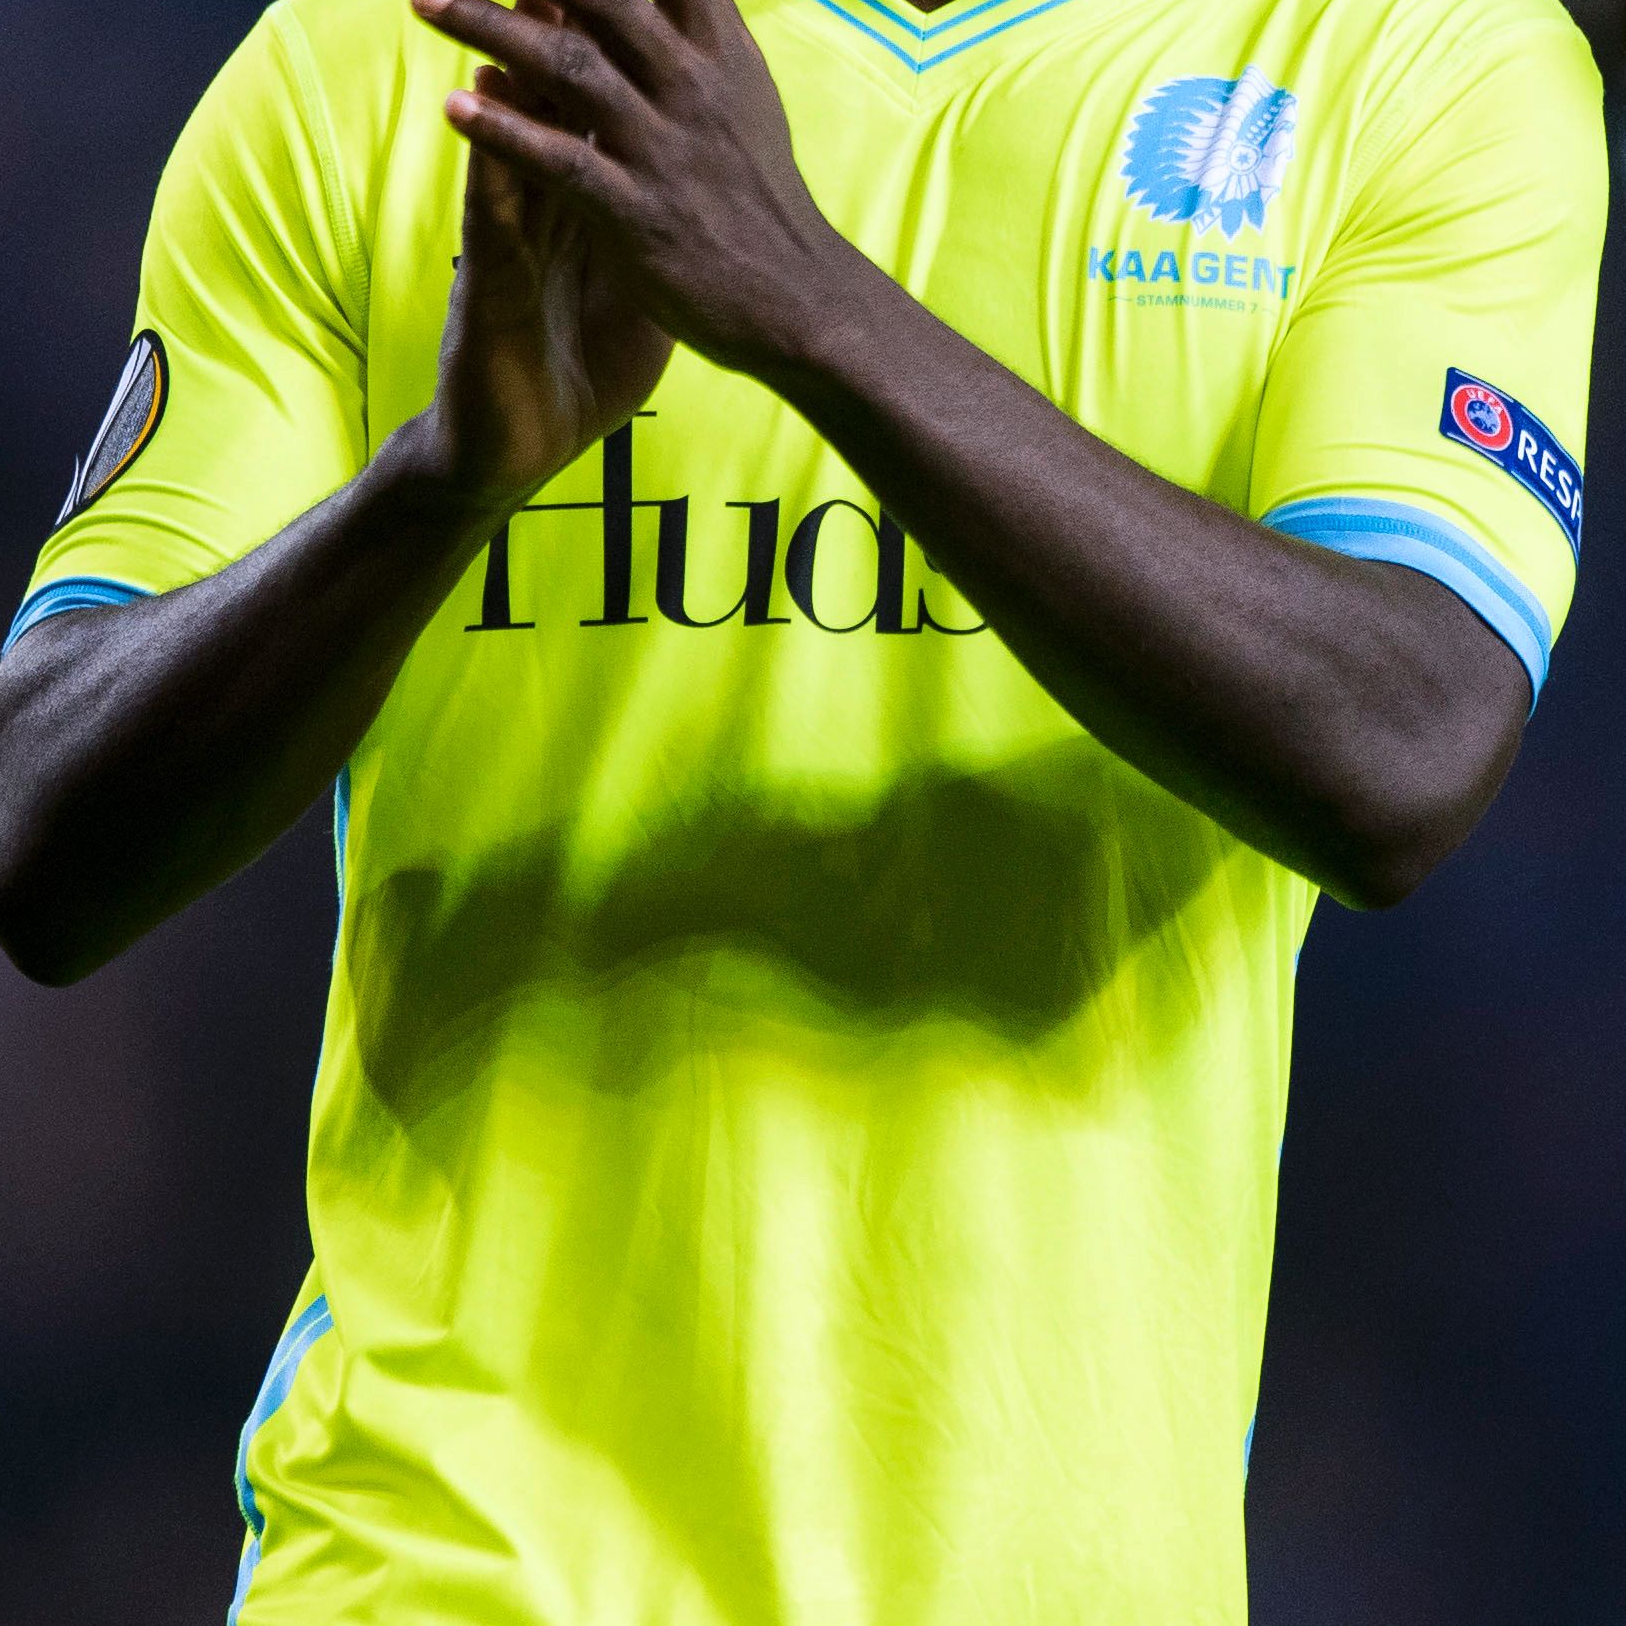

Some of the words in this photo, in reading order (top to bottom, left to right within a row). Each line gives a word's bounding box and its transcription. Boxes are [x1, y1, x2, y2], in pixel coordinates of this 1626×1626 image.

[1088, 247, 1181, 283] KAA
[1192, 251, 1295, 300] GENT
[1136, 294, 1245, 313] STAMNUMMER
